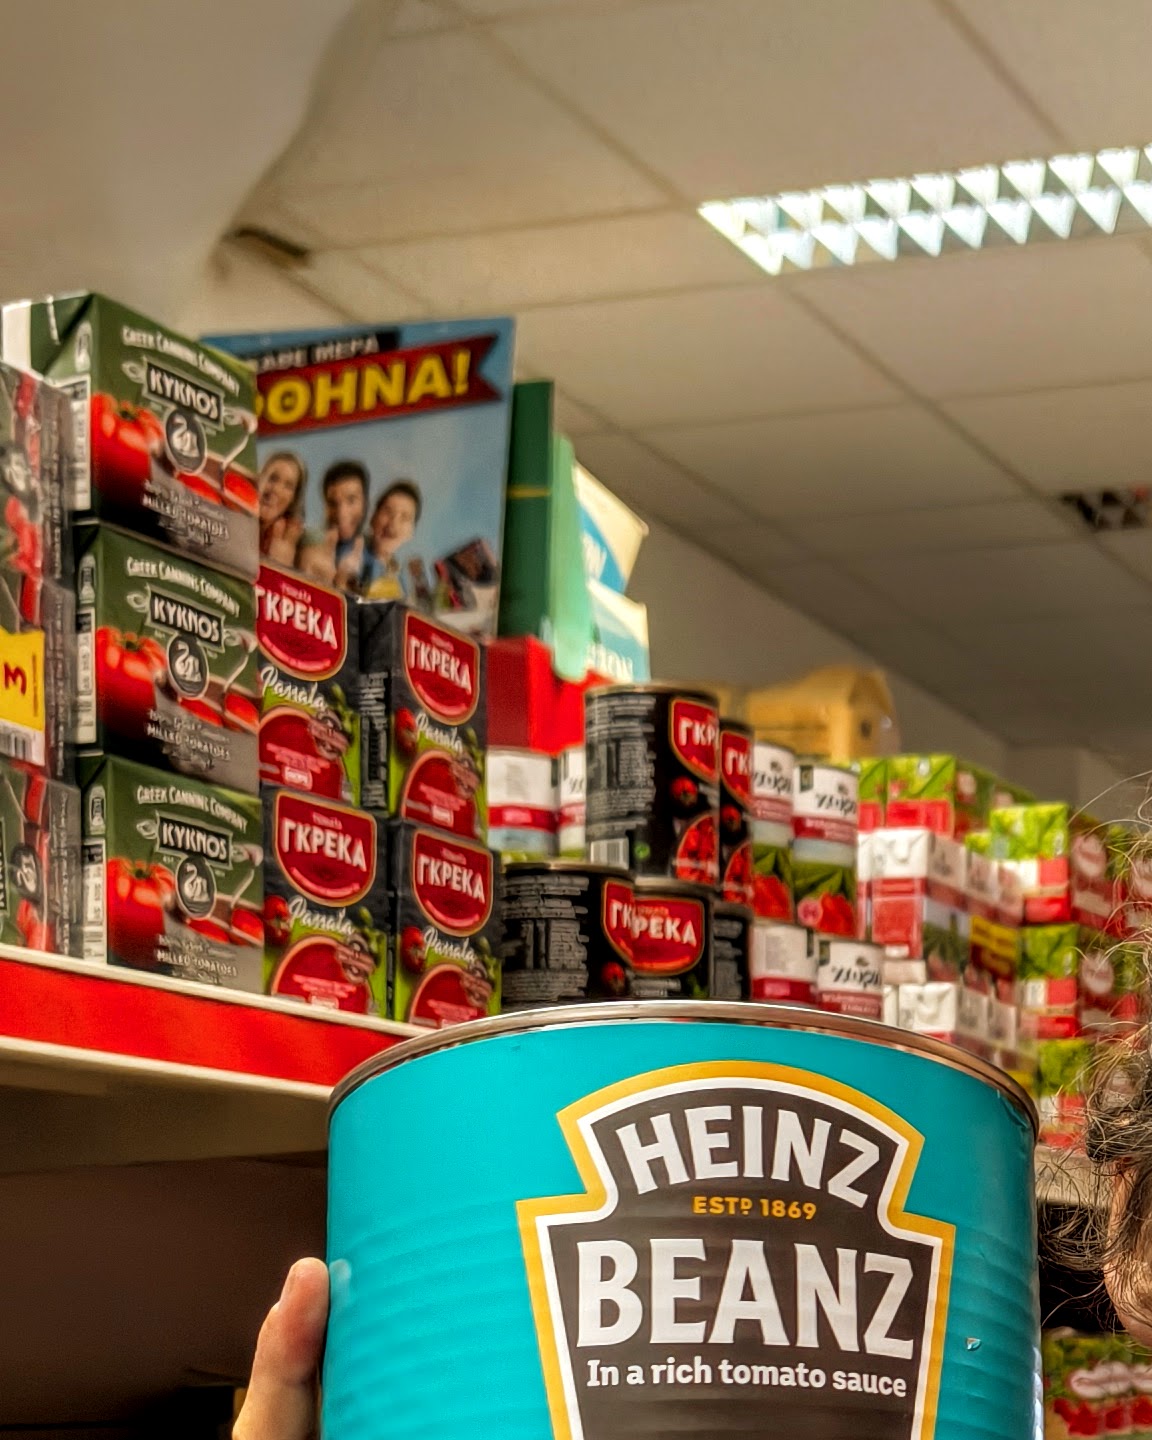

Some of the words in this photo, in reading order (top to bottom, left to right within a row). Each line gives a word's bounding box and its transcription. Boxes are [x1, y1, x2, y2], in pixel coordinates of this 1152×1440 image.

[153, 596, 220, 642] KYKNOS
[162, 822, 227, 860] KYKNOS
[616, 1105, 880, 1208] HEINZ
[760, 1199, 817, 1220] 1869
[577, 1238, 914, 1359] BEANZ
[587, 1359, 619, 1387] In
[626, 1365, 645, 1385] a
[651, 1355, 712, 1384] rich
[718, 1359, 826, 1388] tomato
[832, 1370, 907, 1397] sauce
